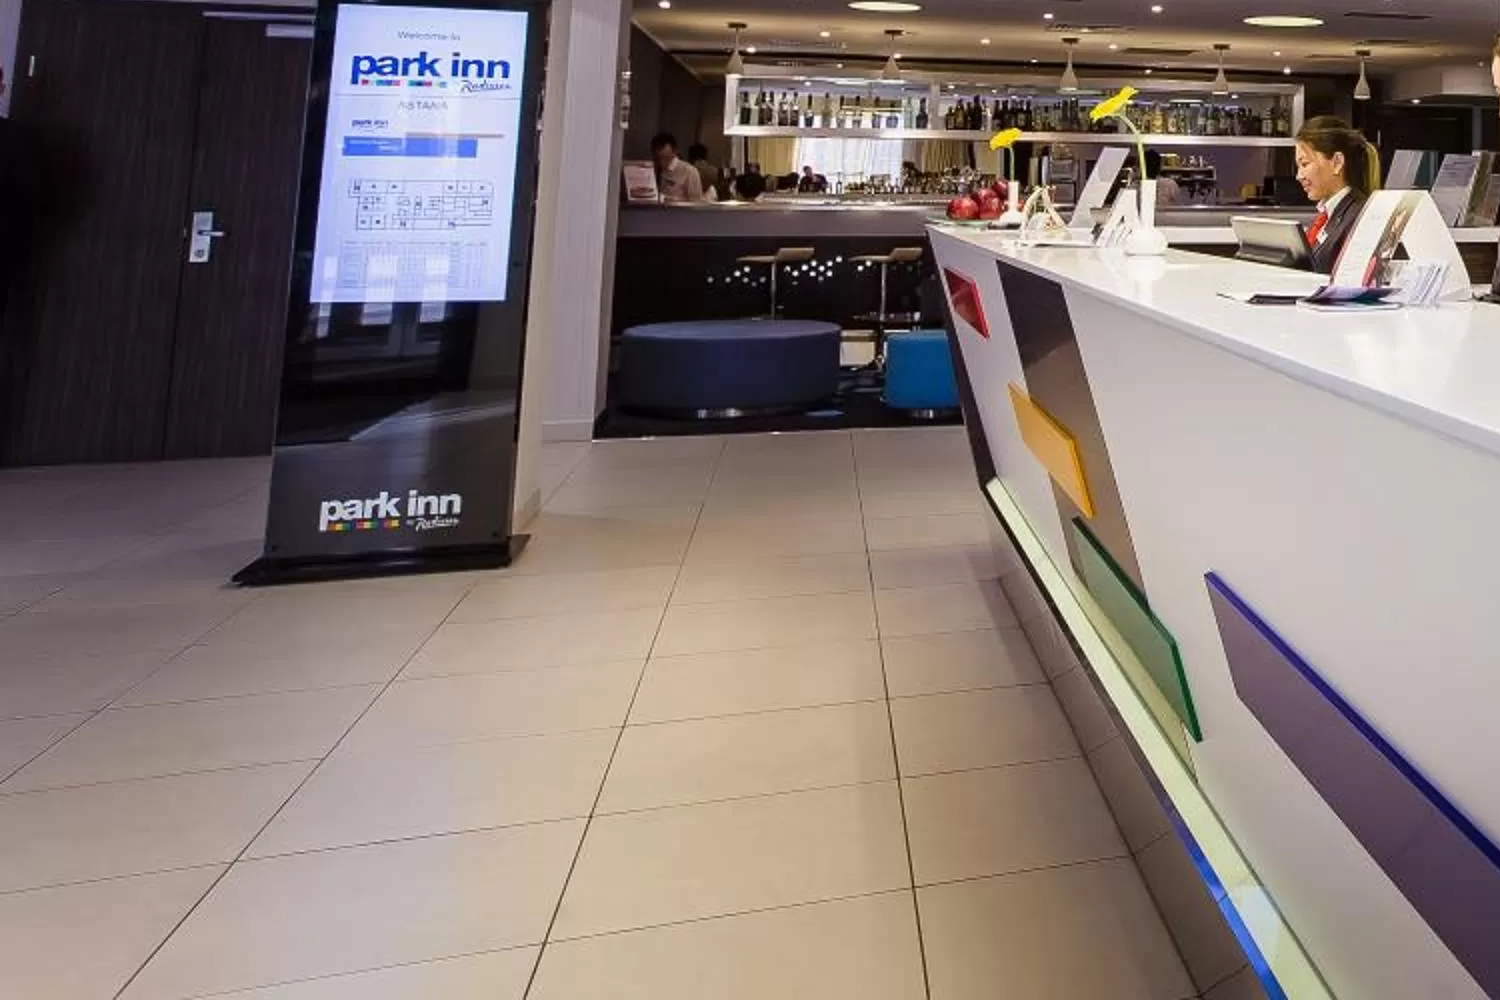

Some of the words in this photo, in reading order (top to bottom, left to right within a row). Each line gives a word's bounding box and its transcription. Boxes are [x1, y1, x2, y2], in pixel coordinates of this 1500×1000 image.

[398, 30, 448, 41] Welcome
[351, 51, 442, 85] park
[451, 51, 511, 78] inn
[319, 491, 401, 532] park
[407, 490, 462, 517] inn
